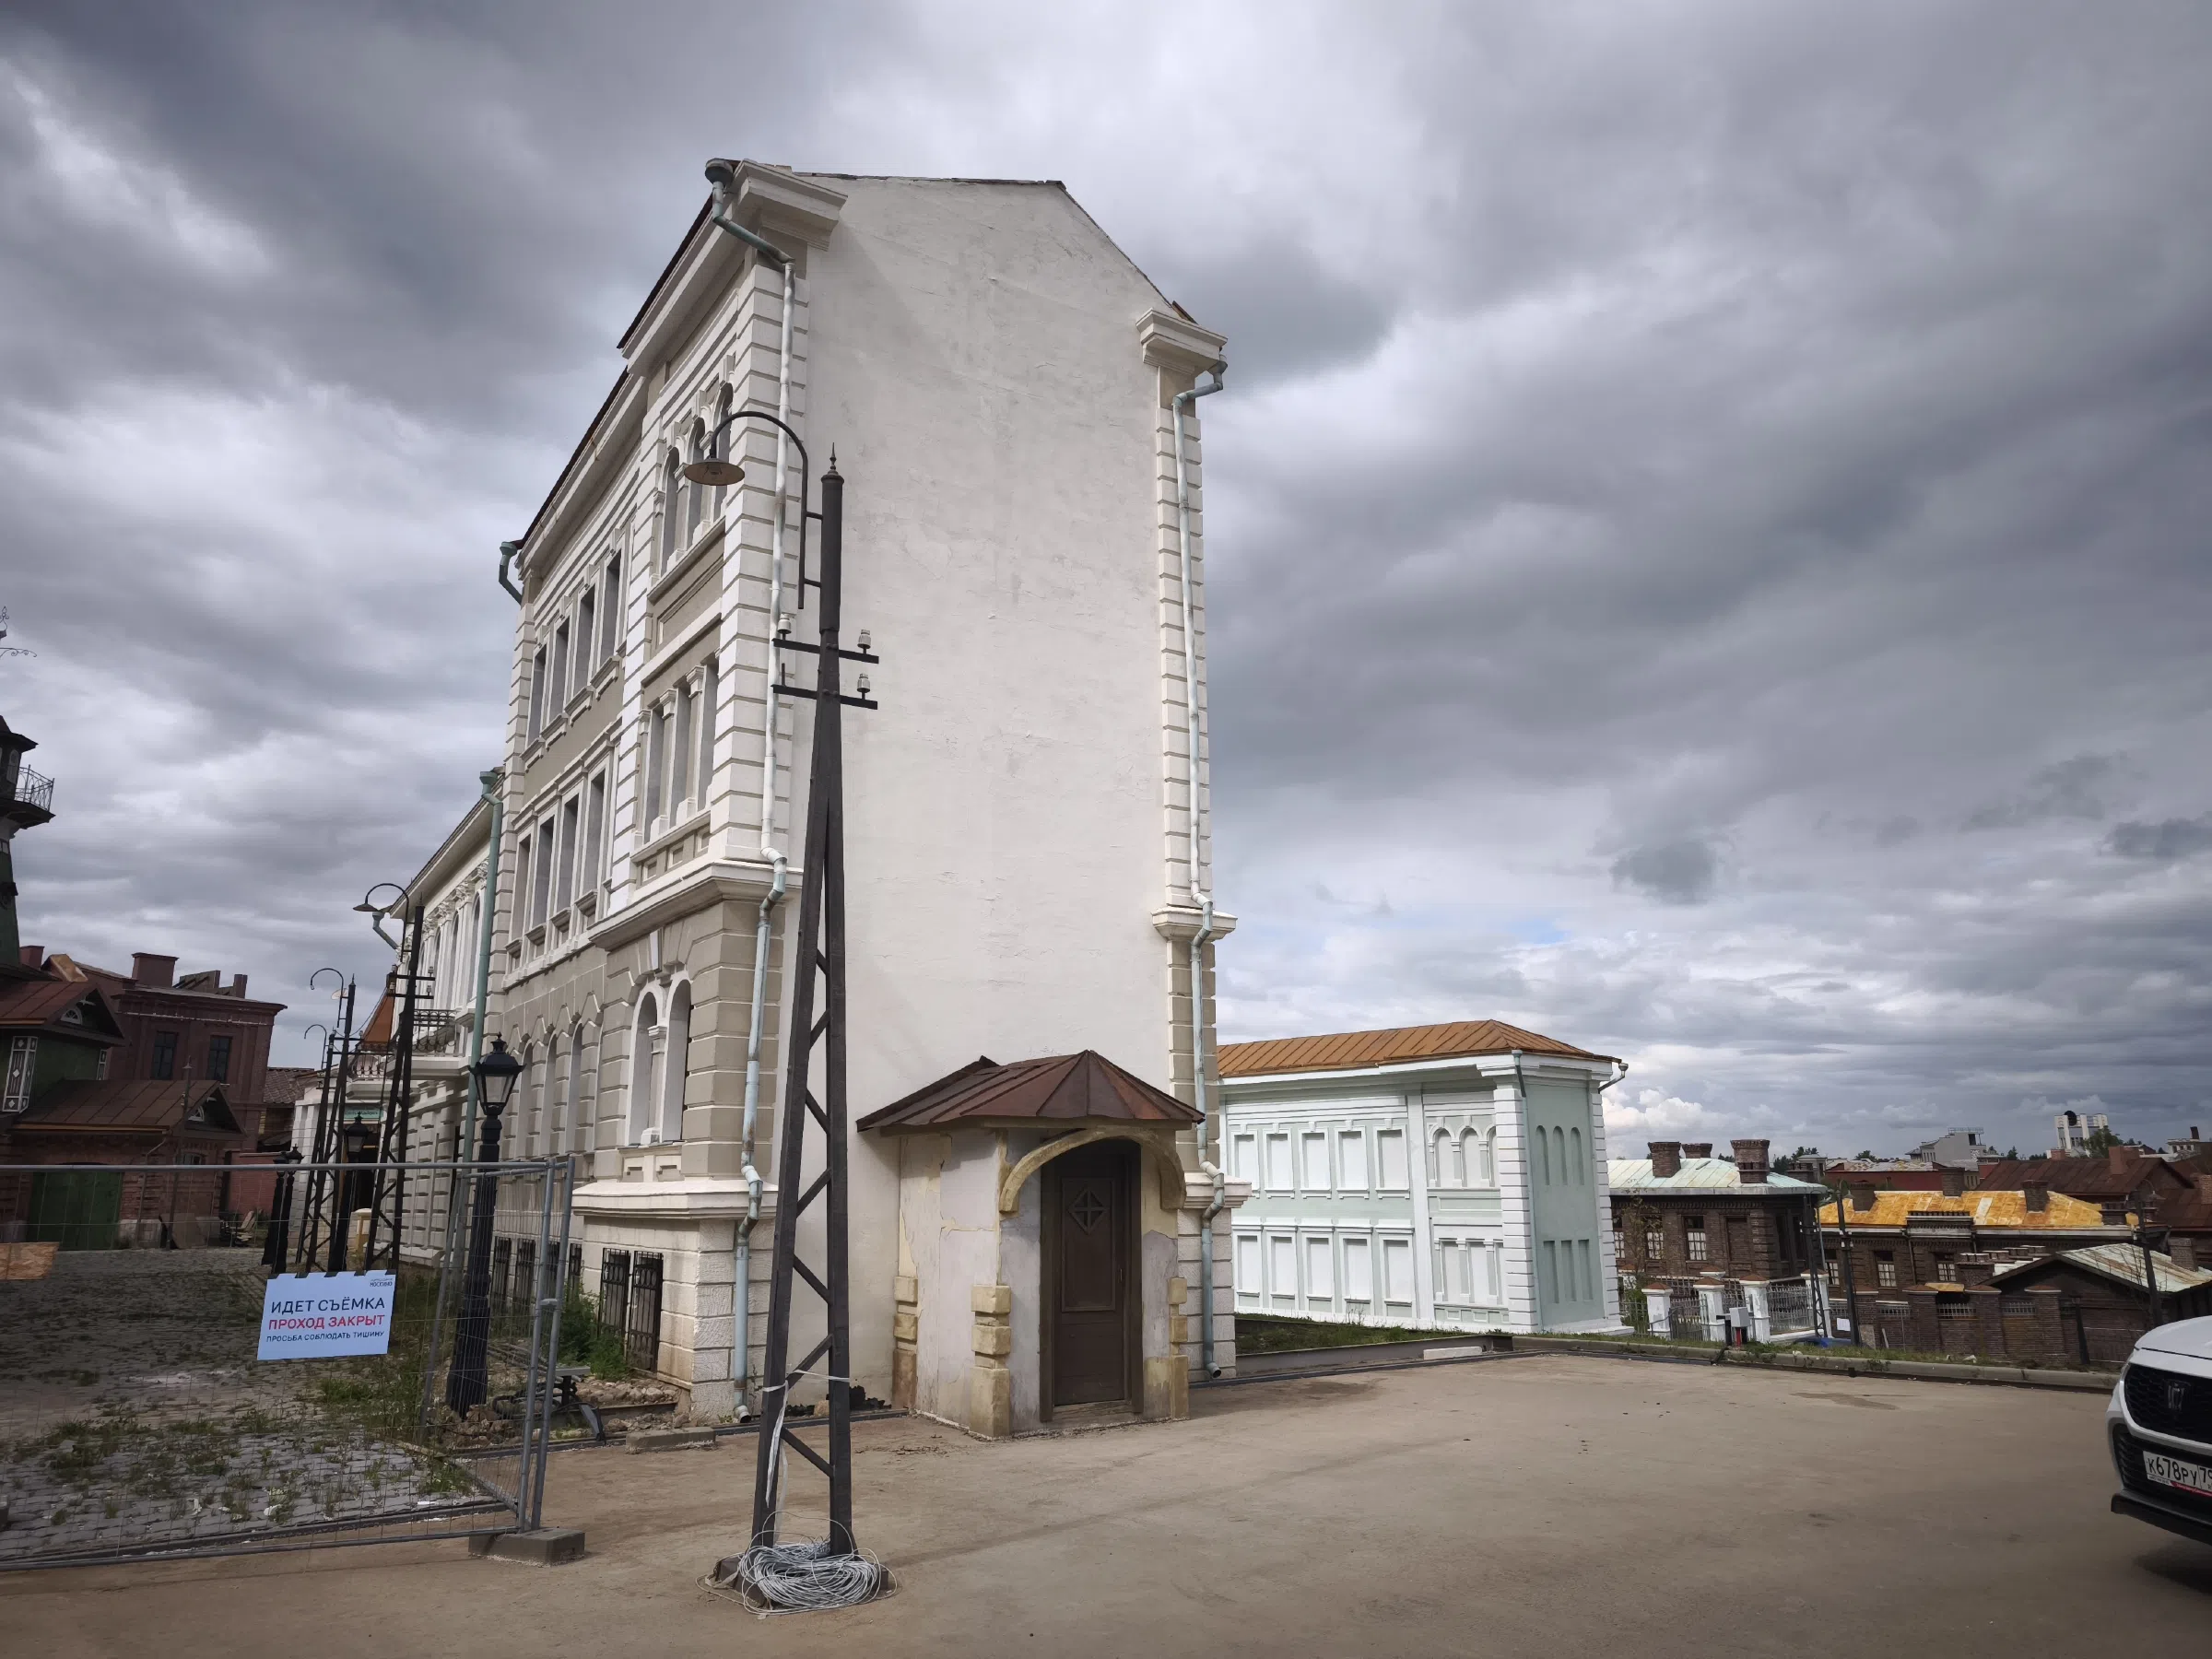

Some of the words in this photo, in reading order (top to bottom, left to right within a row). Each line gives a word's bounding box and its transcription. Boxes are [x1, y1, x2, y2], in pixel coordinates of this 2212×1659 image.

[271, 1300, 314, 1315] ИДЕТ
[318, 1297, 385, 1312] СЪЁМКА
[268, 1317, 325, 1330] ПРОХОД
[328, 1314, 385, 1327] ЗАКРЫТ
[304, 1333, 351, 1341] СОБЛЮДАТЬ
[2147, 1456, 2197, 1486] К678РУ
